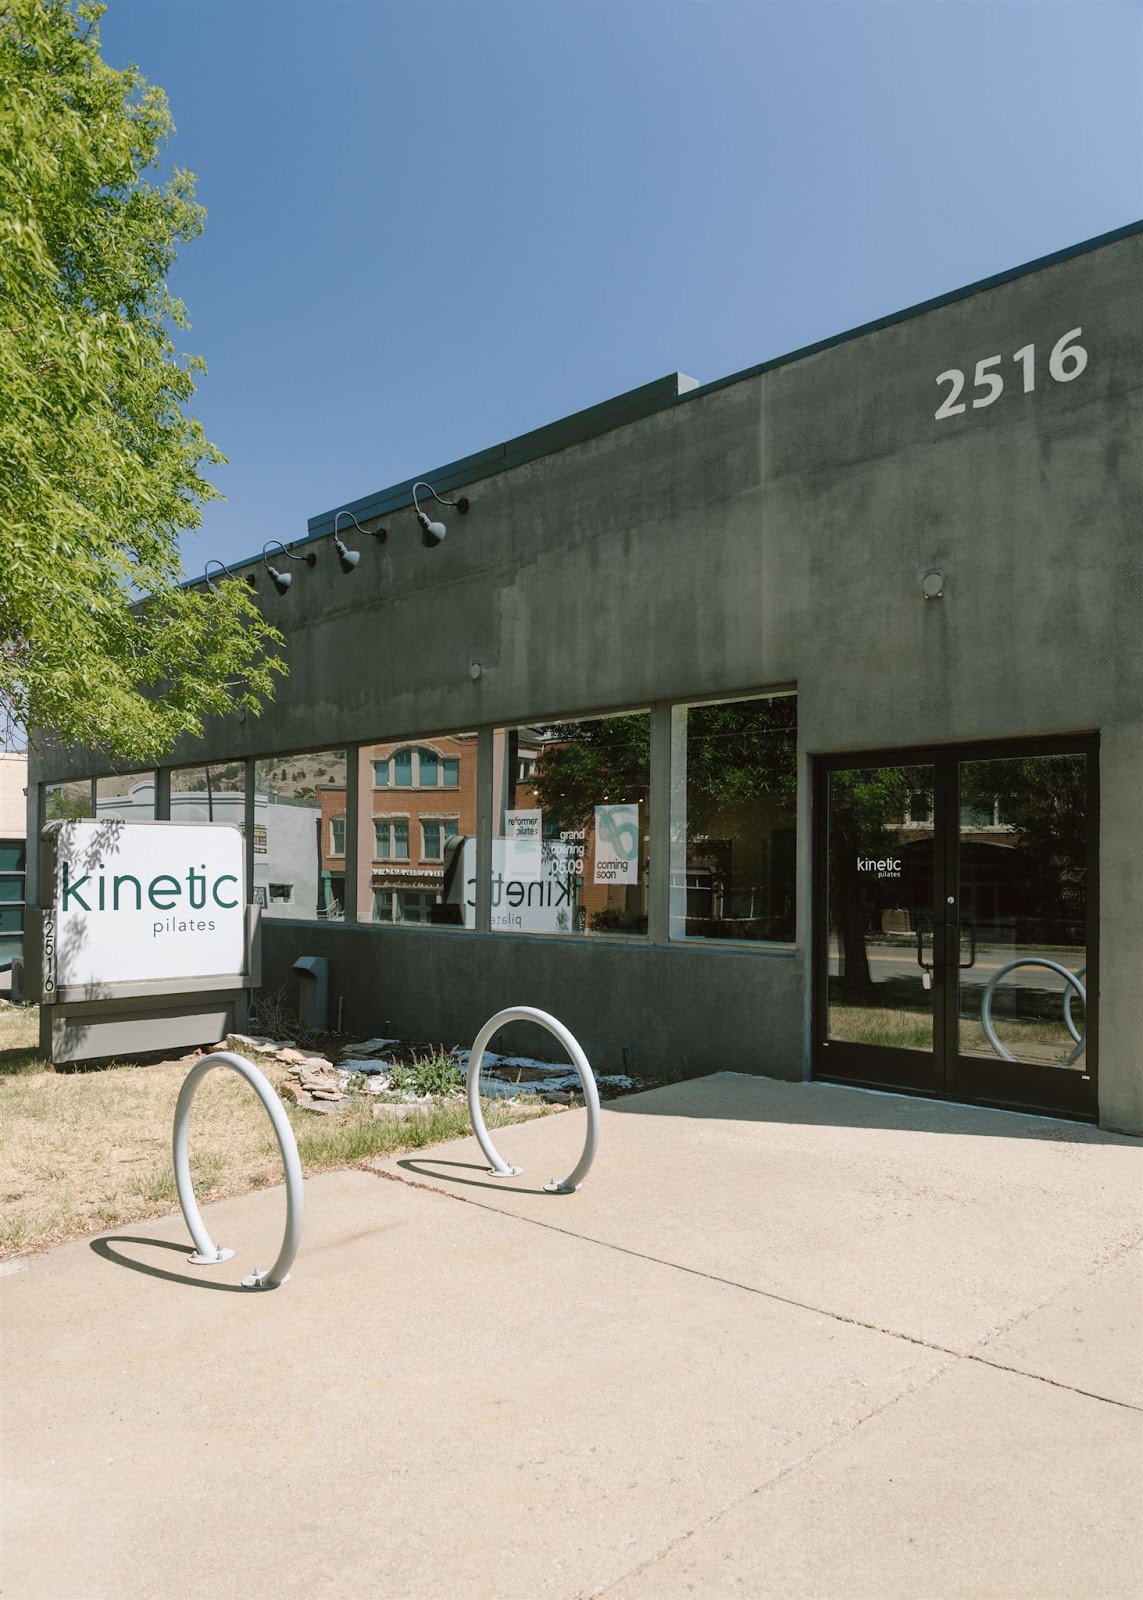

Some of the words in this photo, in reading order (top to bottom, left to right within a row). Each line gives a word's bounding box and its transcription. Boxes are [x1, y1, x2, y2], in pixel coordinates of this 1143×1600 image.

[935, 327, 1088, 420] 2516
[508, 816, 538, 826] reformer
[516, 826, 538, 836] pilates
[560, 828, 585, 842] grand
[551, 842, 584, 857] opening
[597, 859, 628, 872] coming
[857, 857, 901, 871] kinetic
[596, 870, 617, 879] soon
[62, 861, 239, 911] kinetic
[153, 917, 215, 937] pilates
[45, 921, 54, 992] 2516
